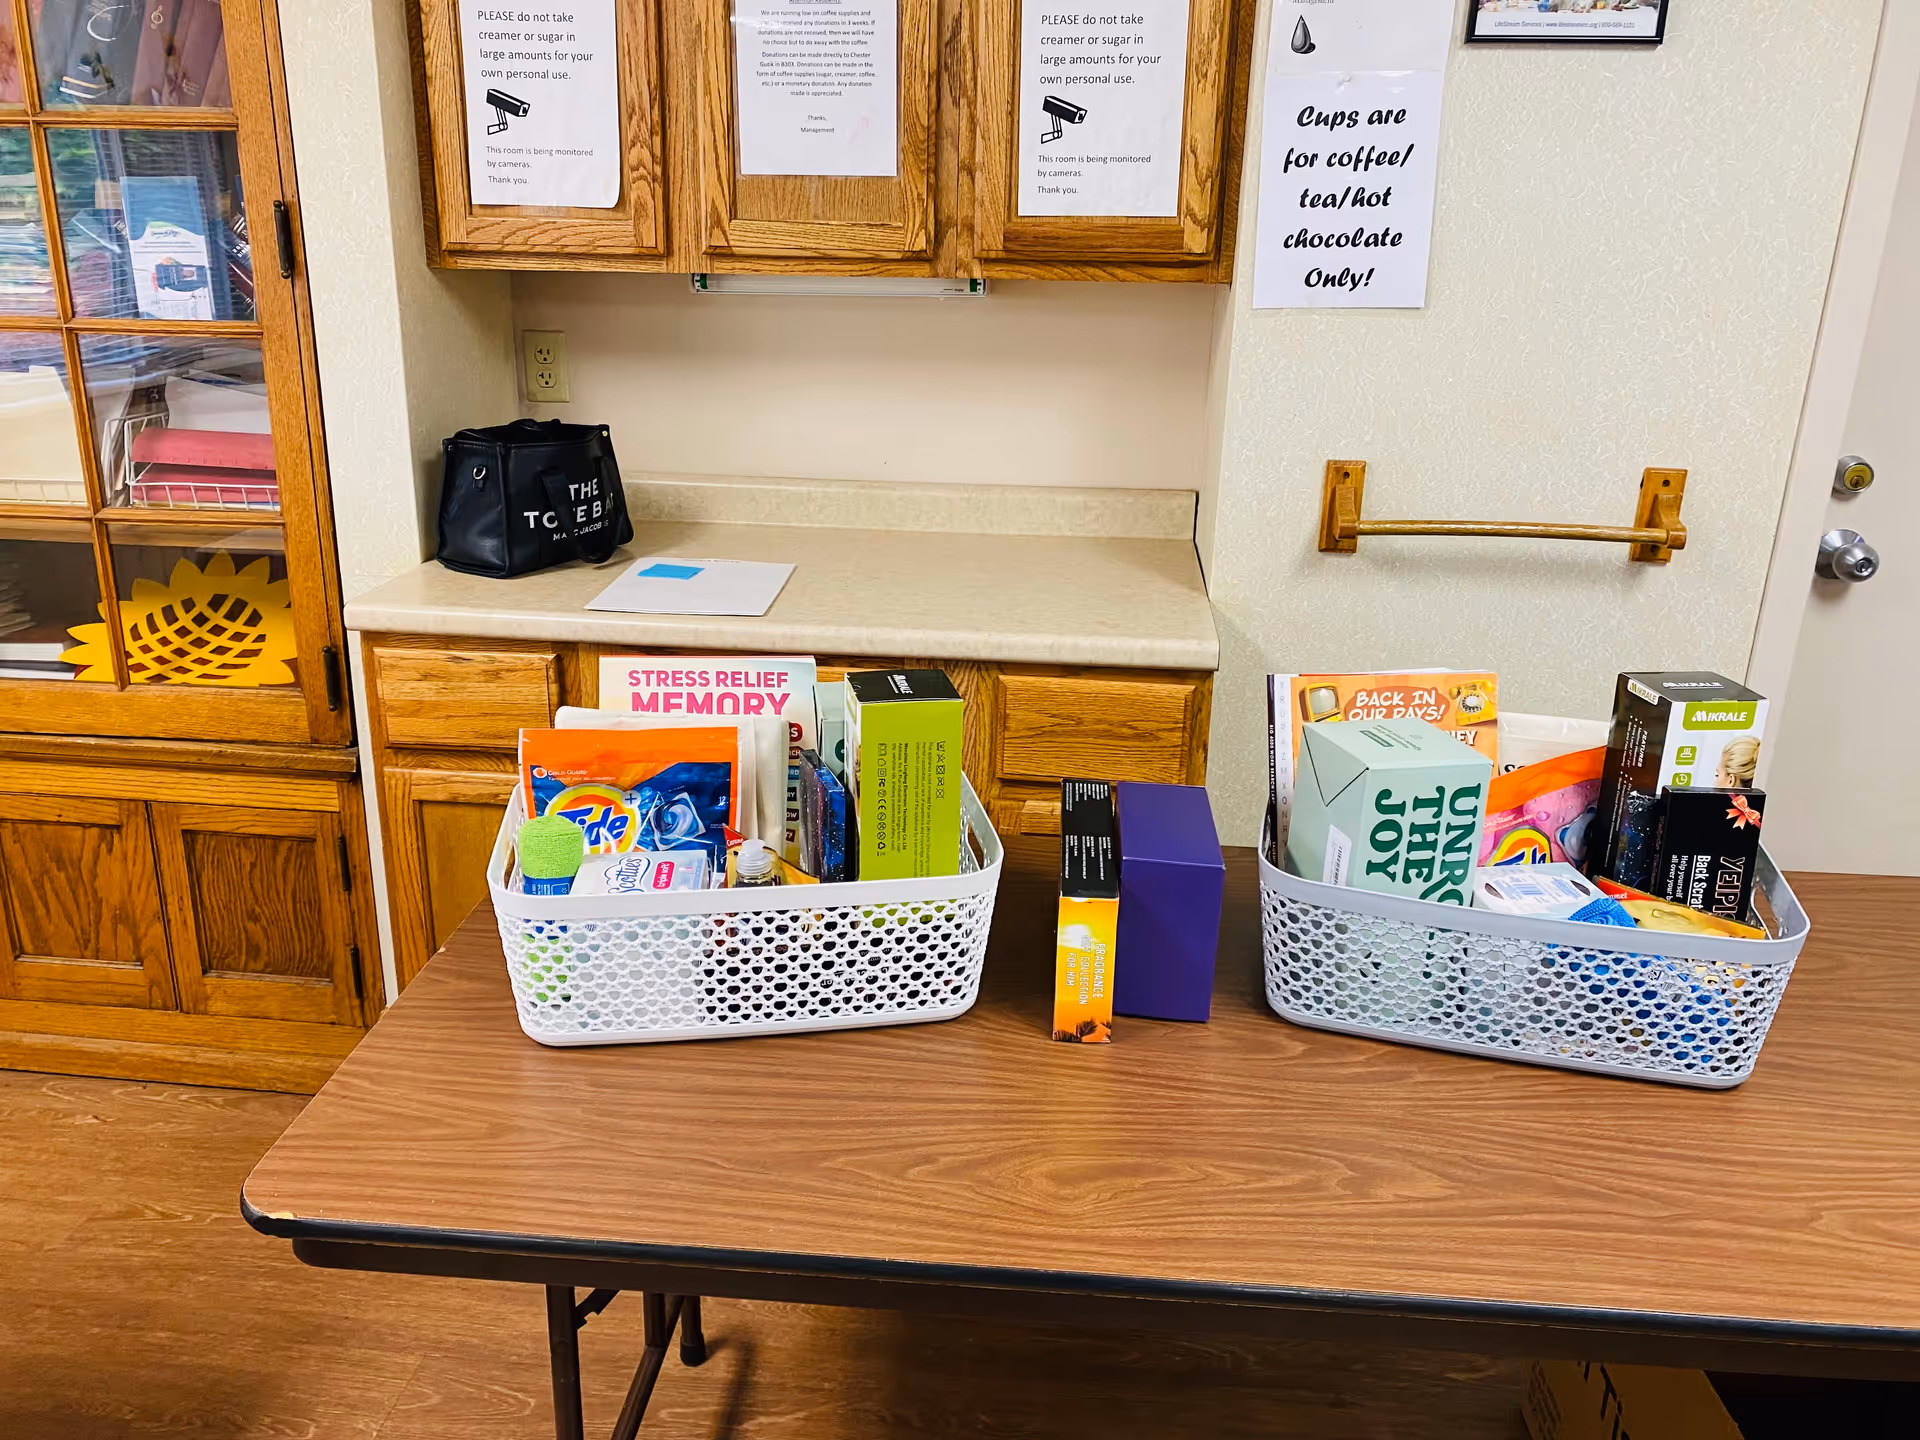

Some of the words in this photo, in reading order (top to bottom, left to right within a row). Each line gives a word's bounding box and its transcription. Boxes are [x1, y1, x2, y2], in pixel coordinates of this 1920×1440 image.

[477, 10, 514, 22] PLEASE
[517, 11, 531, 22] do
[533, 13, 550, 22] not
[552, 12, 574, 23] take
[1041, 14, 1079, 25] PLEASE
[1082, 14, 1097, 25] do
[1099, 15, 1118, 25] not
[1120, 13, 1144, 25] take
[478, 31, 521, 41] creamer
[523, 33, 535, 41] or
[537, 33, 564, 44] sugar
[566, 32, 576, 42] in
[1040, 36, 1085, 45] creamer
[1087, 36, 1099, 45] or
[1102, 36, 1131, 47] sugar
[1134, 33, 1144, 44] in
[479, 48, 505, 62] large
[508, 51, 552, 61] amounts
[554, 50, 569, 61] for
[570, 53, 594, 63] your
[1040, 54, 1066, 67] large
[1069, 55, 1116, 65] amounts
[1118, 53, 1134, 64] for
[1136, 55, 1162, 66] your
[481, 69, 503, 78] own
[506, 69, 549, 80] personal
[551, 72, 571, 80] use.
[1039, 76, 1062, 85] own
[1065, 73, 1111, 86] personal
[1113, 75, 1135, 84] use.
[1296, 105, 1360, 132] Cups
[1367, 108, 1407, 126] are
[485, 145, 502, 154] This
[533, 147, 554, 157] being
[1283, 147, 1319, 174] for
[1326, 143, 1415, 172] coffee/
[486, 159, 497, 169] by
[1038, 155, 1054, 163] This
[1086, 155, 1108, 165] being
[1109, 155, 1152, 163] monitored
[487, 175, 512, 184] Thank
[1037, 169, 1047, 178] by
[1037, 185, 1061, 194] Thank
[1299, 185, 1392, 210] tea/hot
[1283, 226, 1403, 249] chocolate
[1304, 267, 1375, 292] Only!
[568, 478, 599, 501] THE
[523, 505, 588, 529] TOE
[593, 492, 614, 518] BA
[553, 529, 579, 540] MAC
[580, 520, 609, 535] JACOBS
[628, 670, 710, 687] STRESS
[716, 671, 788, 688] RELIEF
[1356, 691, 1404, 707] BACK
[1411, 690, 1435, 705] IN
[1629, 682, 1657, 703] MIKRALE
[632, 692, 791, 715] MEMORY
[1349, 708, 1386, 721] OUR
[1393, 704, 1446, 721] DAYS!
[1692, 710, 1747, 722] MIKRALE
[1637, 730, 1648, 768] FEATURES
[1366, 788, 1406, 883] JOY
[1402, 785, 1446, 884] THE
[1678, 855, 1688, 871] Help
[1694, 855, 1711, 880] Back
[1676, 872, 1684, 898] yourself
[1690, 882, 1707, 909] Scrat
[1067, 952, 1077, 968] FOR
[1066, 971, 1076, 986] HIM
[1093, 943, 1106, 999] FRAGRANCE
[1079, 956, 1090, 1005] COLLECTION
